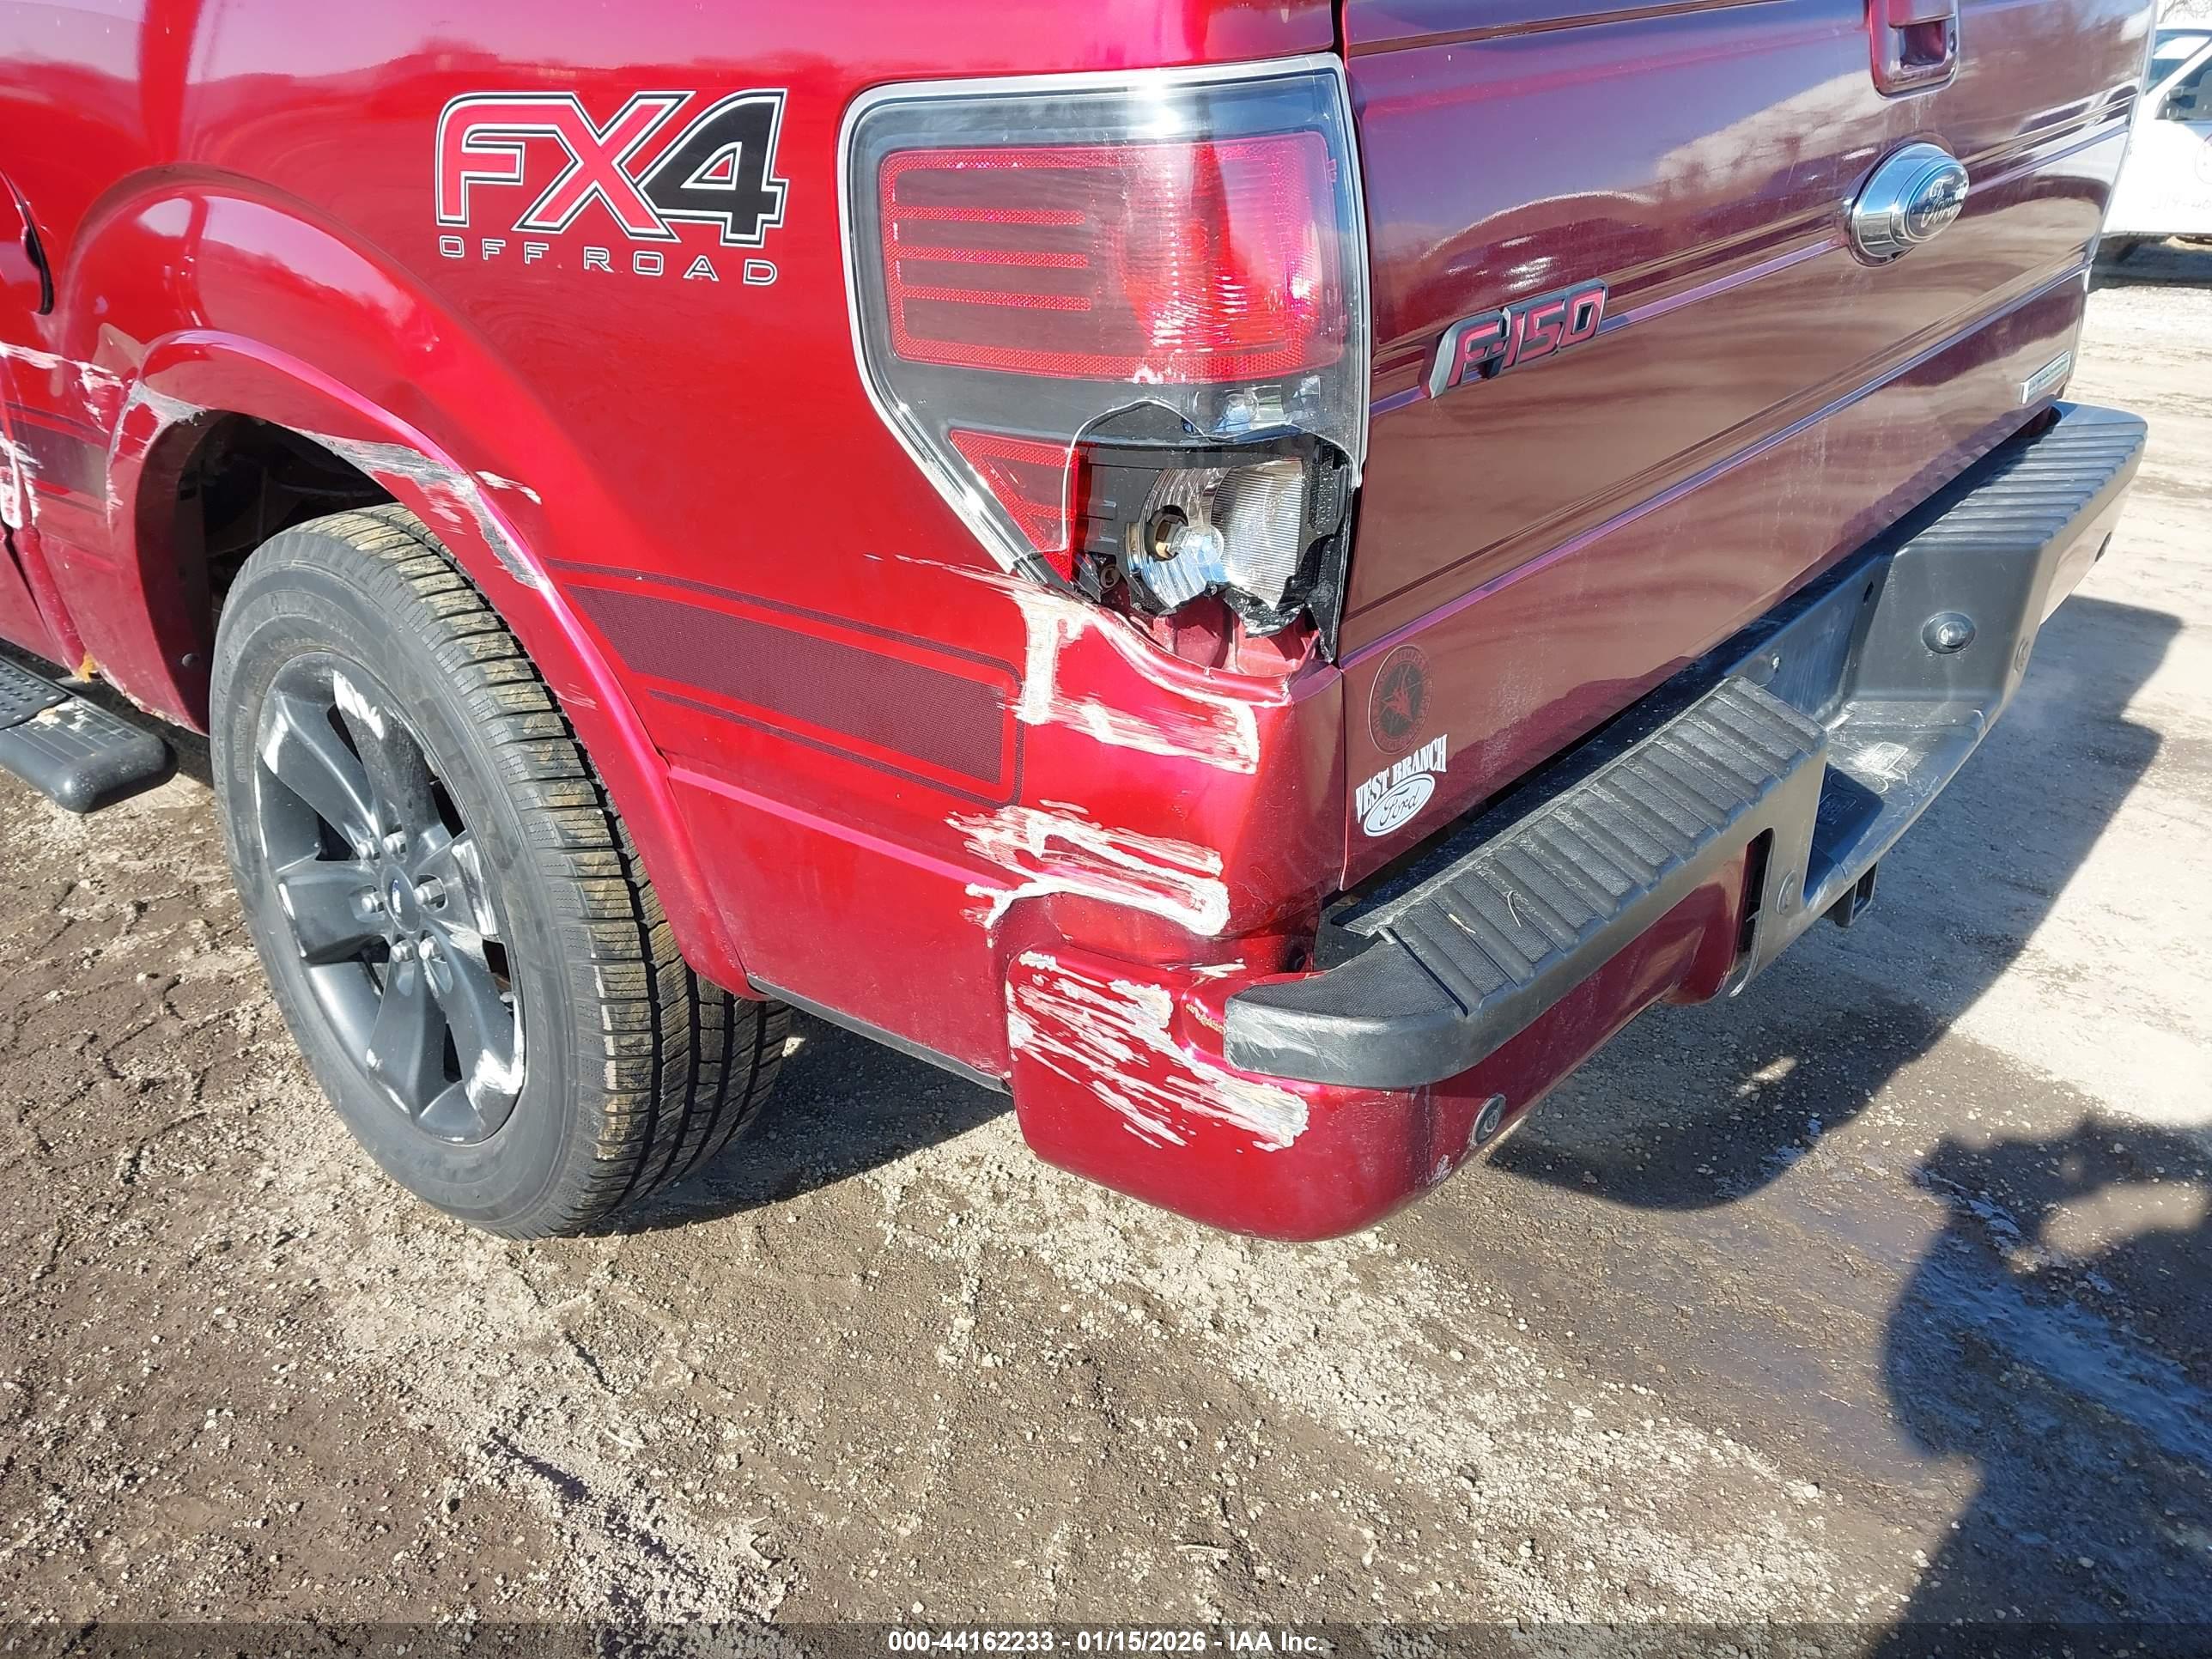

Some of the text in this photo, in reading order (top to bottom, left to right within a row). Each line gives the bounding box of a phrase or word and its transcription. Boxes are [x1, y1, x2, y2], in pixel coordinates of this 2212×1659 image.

[434, 88, 790, 249] FX4
[1920, 174, 1967, 228] Ford
[438, 234, 779, 287] OFF ROAD
[1429, 277, 1608, 399] F-150
[1392, 733, 1448, 787] BRANCH
[1379, 786, 1420, 827] Ford
